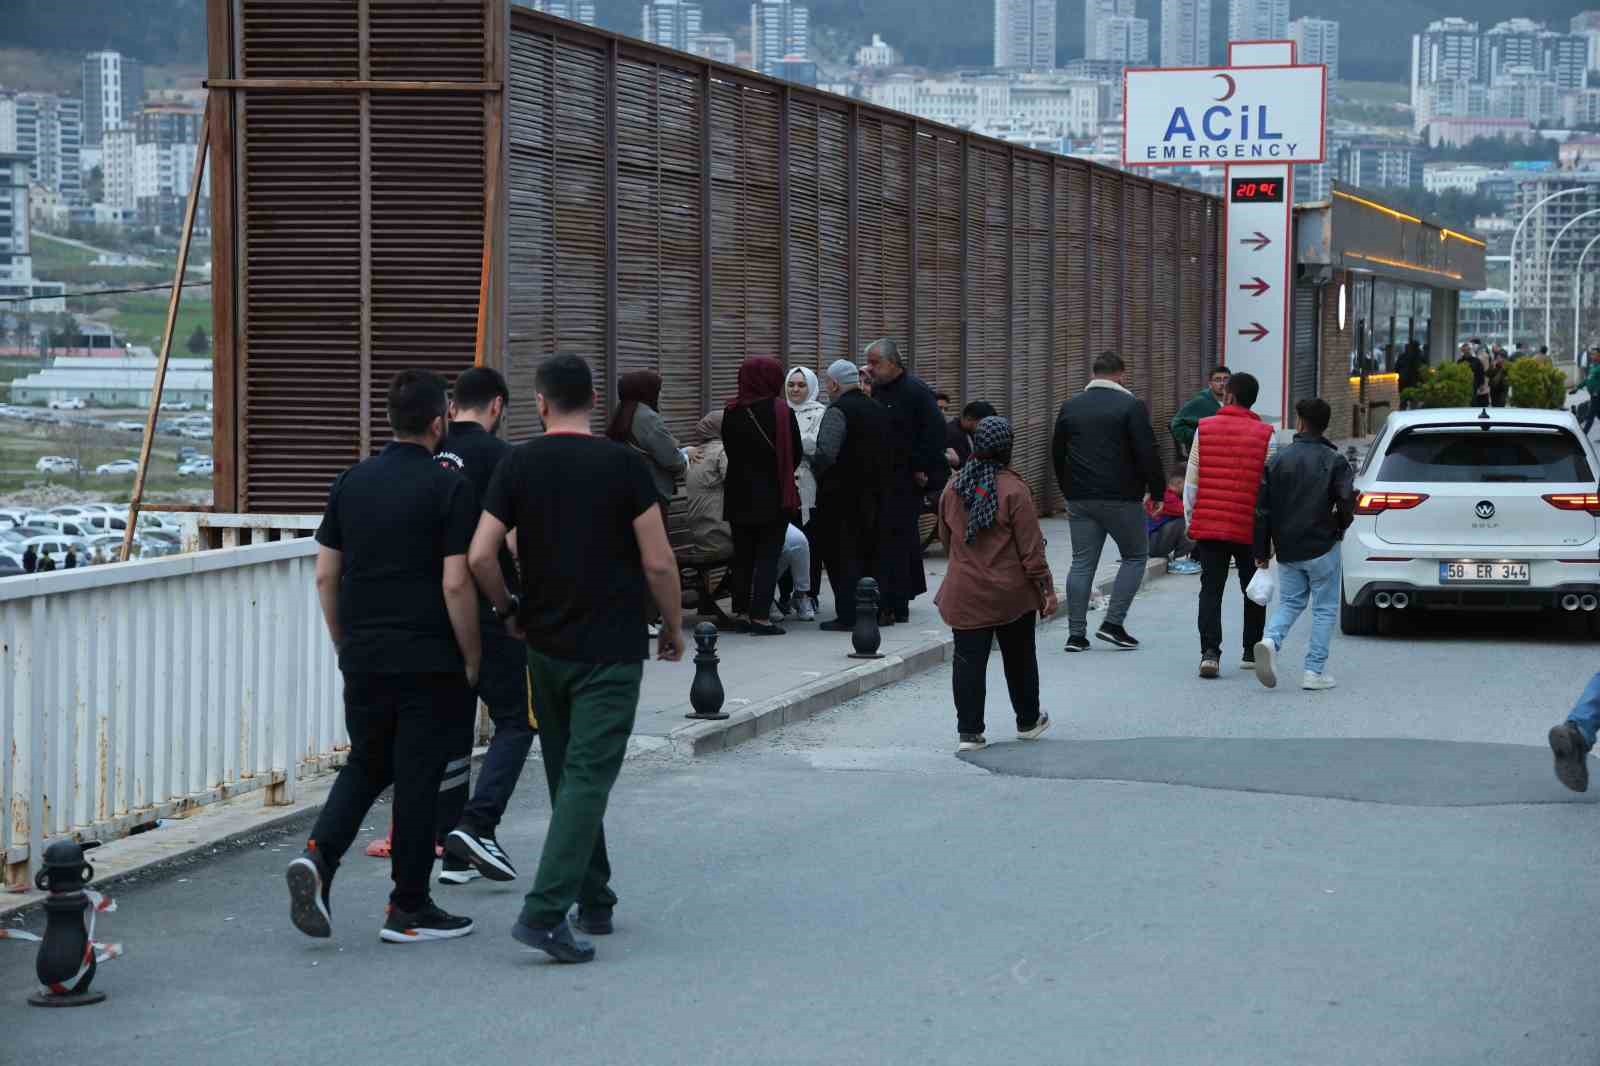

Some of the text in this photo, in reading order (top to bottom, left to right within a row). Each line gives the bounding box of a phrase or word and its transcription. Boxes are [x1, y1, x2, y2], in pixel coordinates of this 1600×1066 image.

[1147, 144, 1297, 158] EMERGENCY
[1236, 183, 1256, 197] 20
[1448, 564, 1528, 579] 58 ER 344
